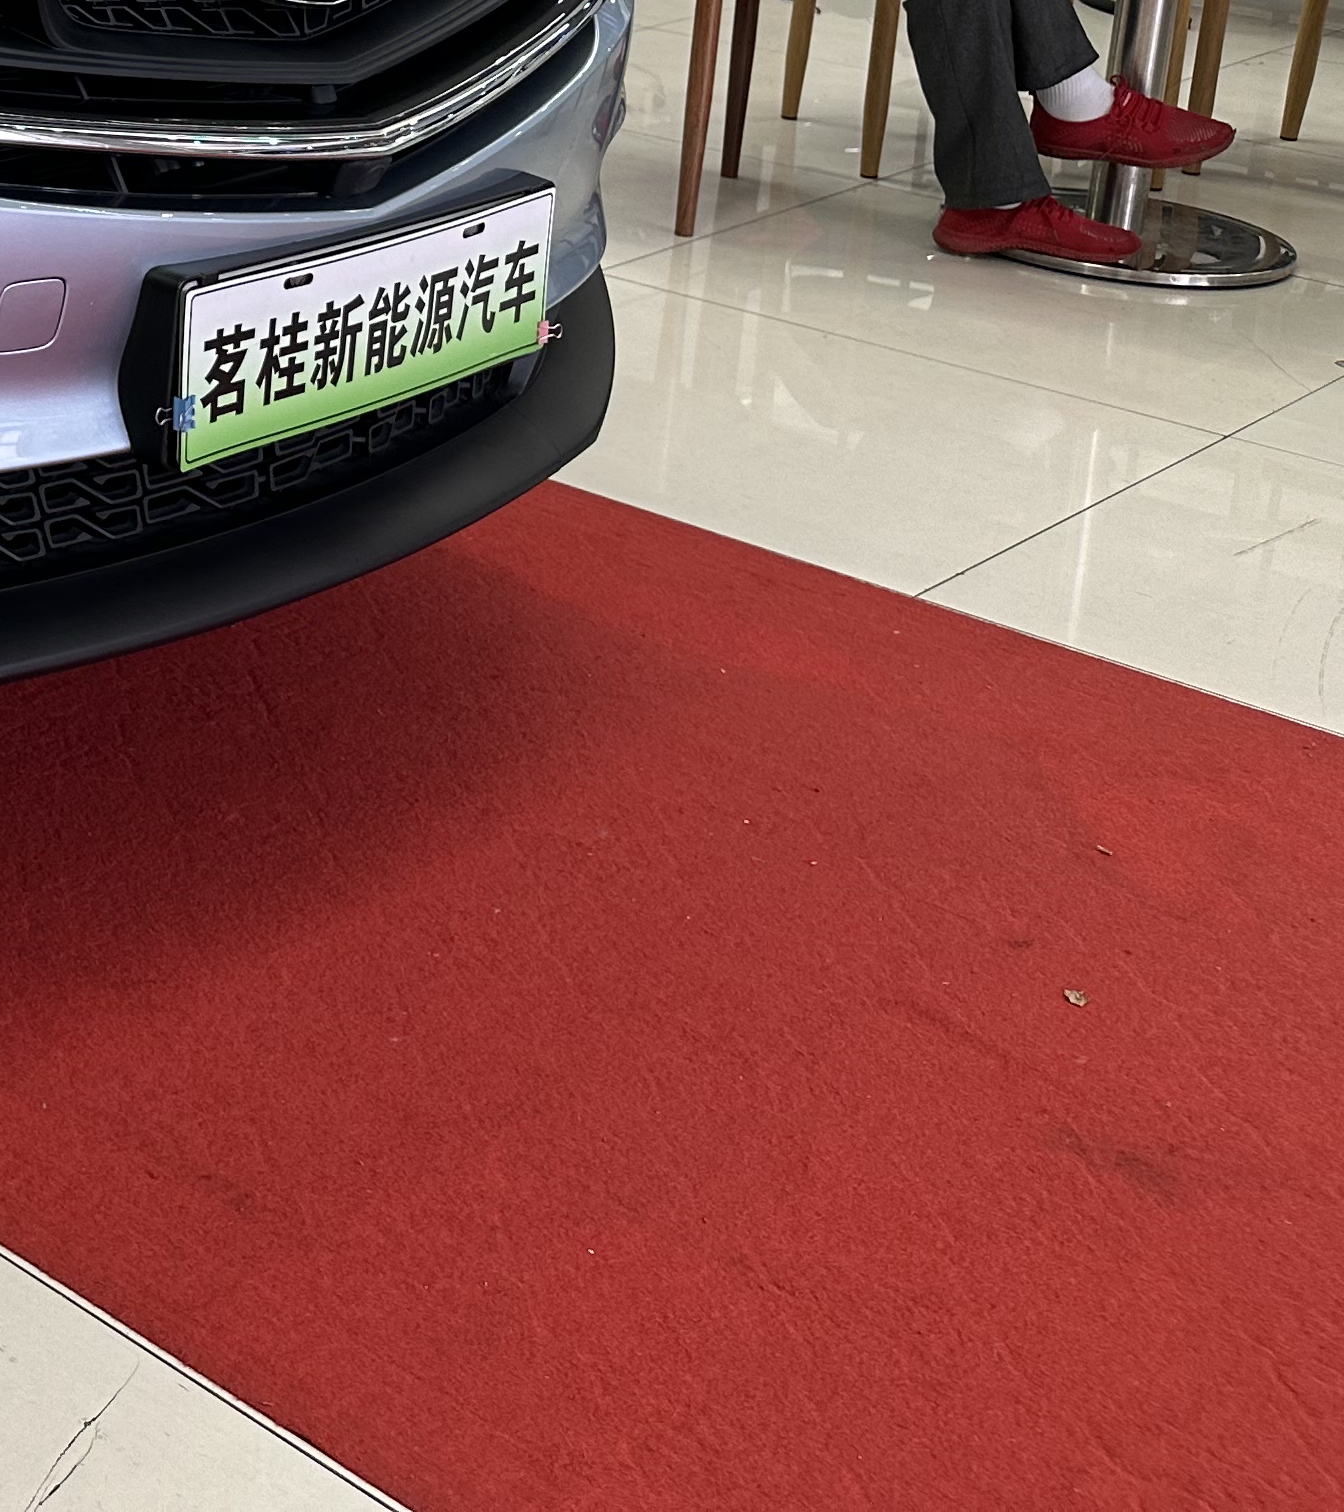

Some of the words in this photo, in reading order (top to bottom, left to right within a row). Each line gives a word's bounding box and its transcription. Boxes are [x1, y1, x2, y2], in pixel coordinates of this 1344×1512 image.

[200, 240, 540, 424] 茗桂新能源汽车
